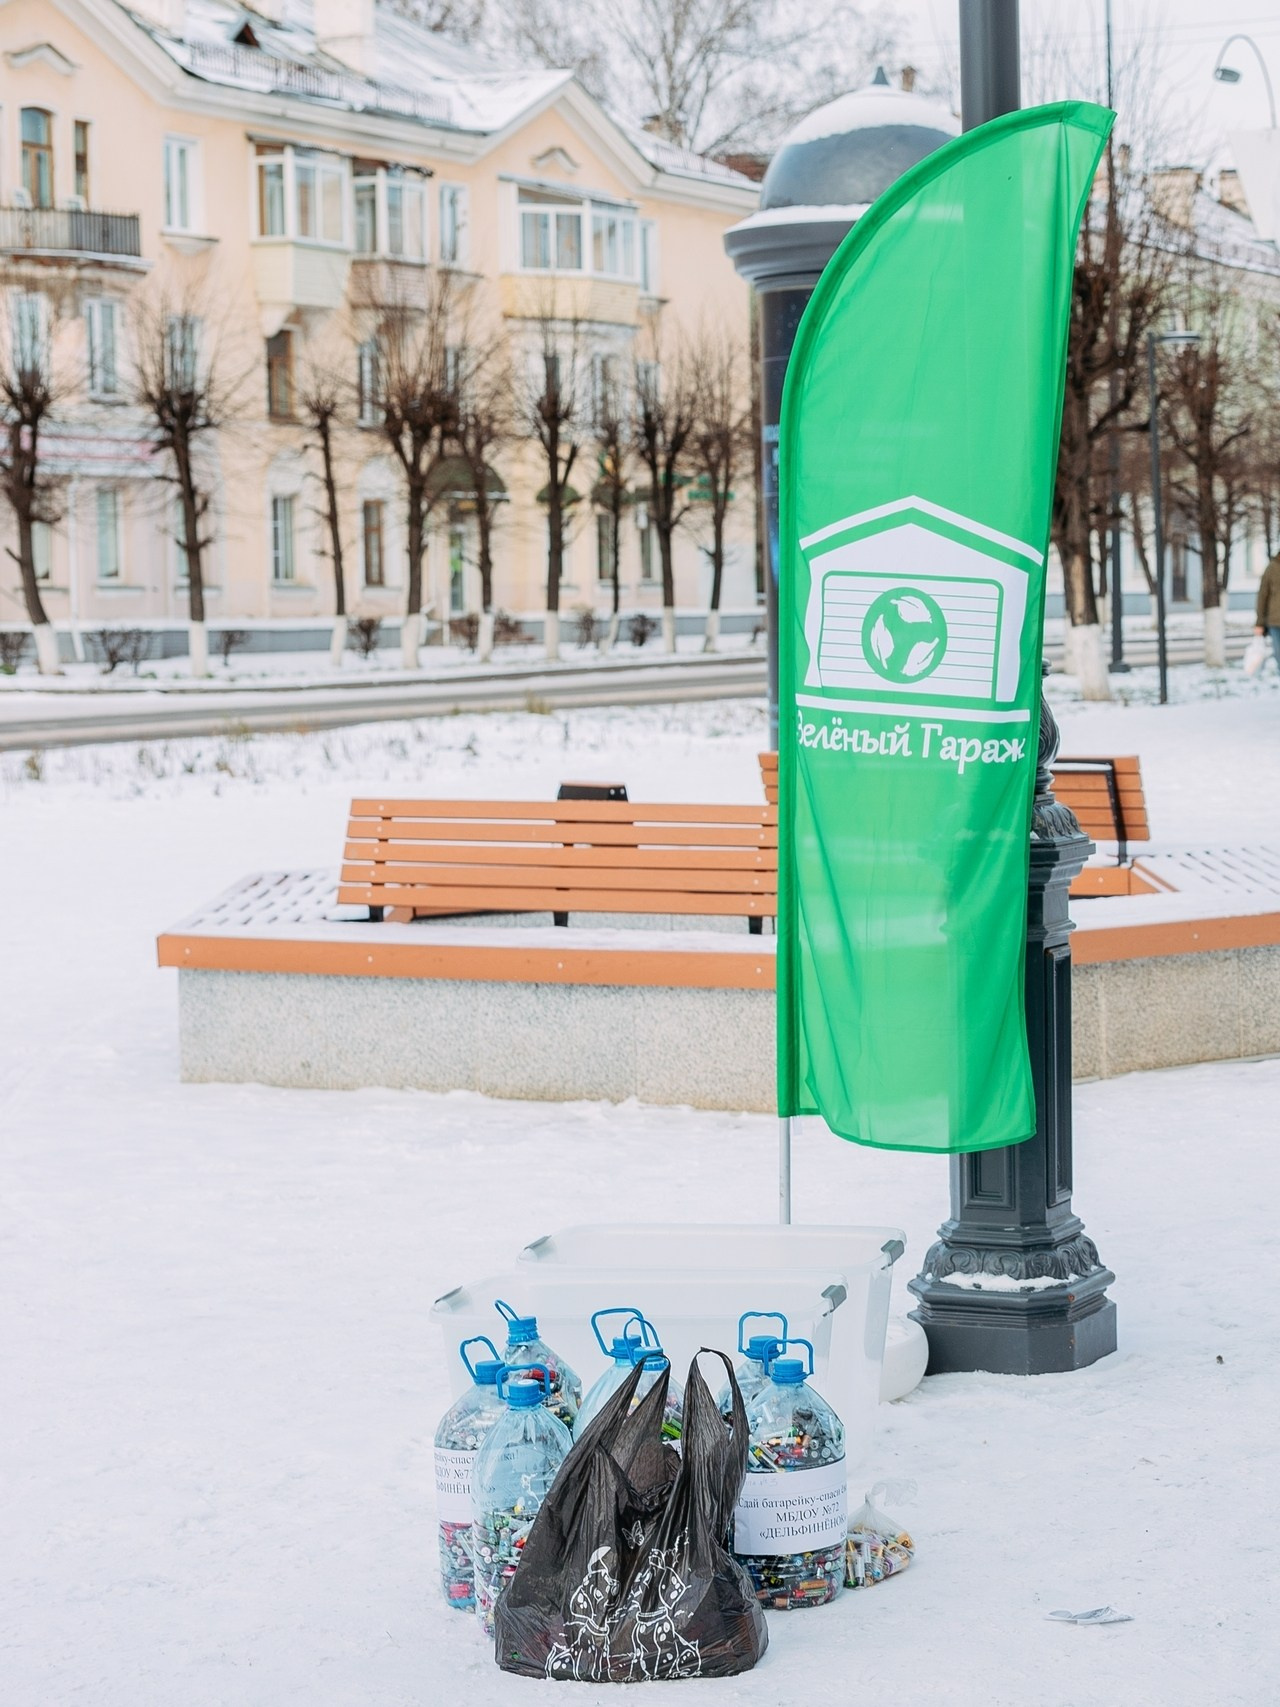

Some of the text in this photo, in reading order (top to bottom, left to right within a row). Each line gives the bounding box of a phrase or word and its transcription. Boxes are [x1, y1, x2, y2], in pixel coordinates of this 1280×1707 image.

[921, 723, 1025, 774] Гараж
[738, 1497, 759, 1509] Сдай
[776, 1507, 819, 1523] МБДОУ
